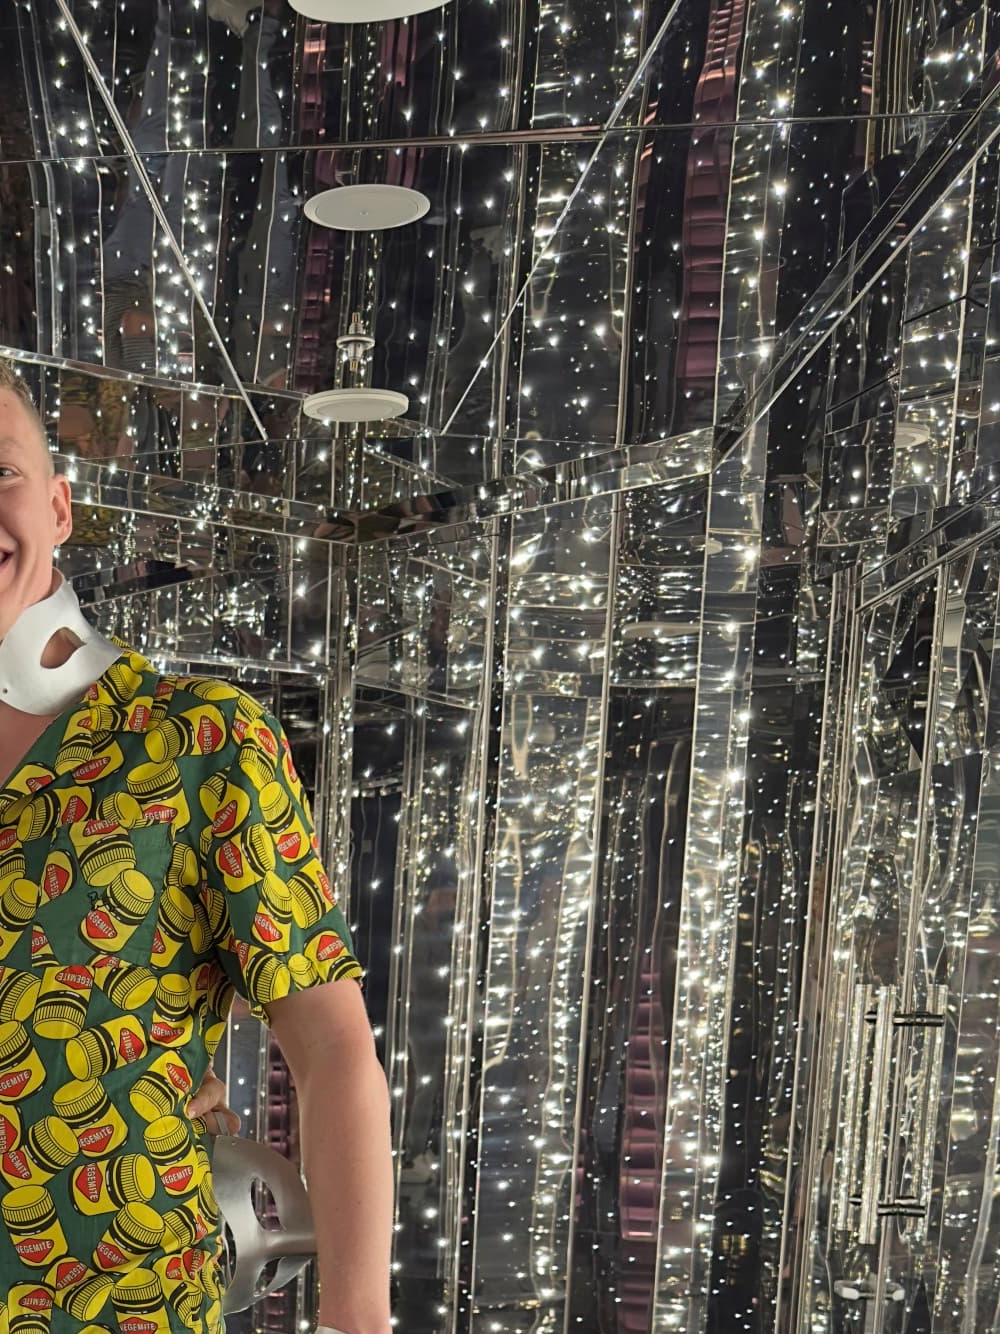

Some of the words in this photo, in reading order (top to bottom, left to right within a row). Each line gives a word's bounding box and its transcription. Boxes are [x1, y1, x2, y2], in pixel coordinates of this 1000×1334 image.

[201, 719, 211, 754] VEGEMITE
[86, 909, 116, 938] VEGEMITE
[57, 972, 93, 987] VEGEMITE
[87, 1163, 97, 1200] VEGEMITE
[160, 1166, 193, 1185] VEGEMITE
[15, 1240, 52, 1254] VEGEMITE
[55, 1261, 86, 1289] VEGEMITE
[120, 1323, 154, 1331] VEGEMITE
